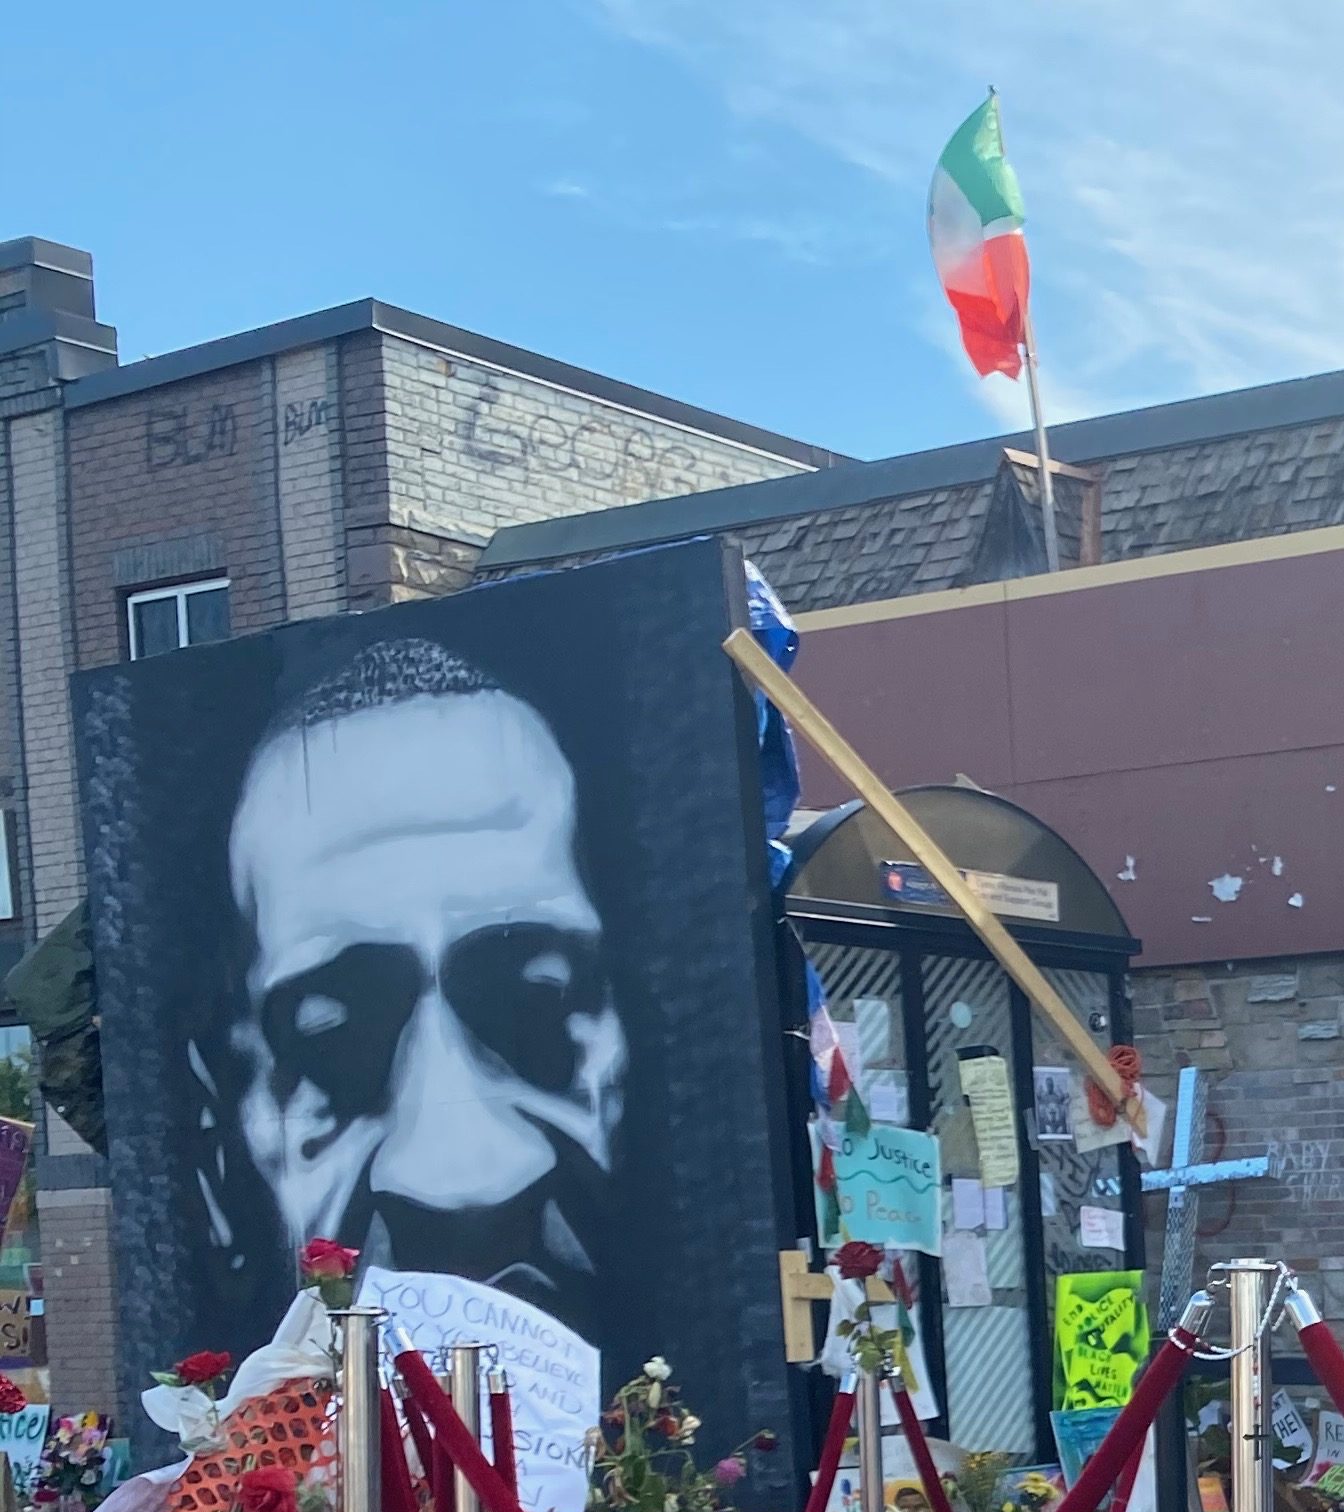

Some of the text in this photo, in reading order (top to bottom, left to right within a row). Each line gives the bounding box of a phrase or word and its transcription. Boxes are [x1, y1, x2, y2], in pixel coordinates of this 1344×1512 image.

[283, 402, 329, 447] BLM
[867, 1138, 932, 1178] Justice
[1266, 1139, 1331, 1180] BABY
[373, 1279, 452, 1318] YOU
[464, 1297, 577, 1361] CANNOT
[1089, 1363, 1117, 1380] LIVES
